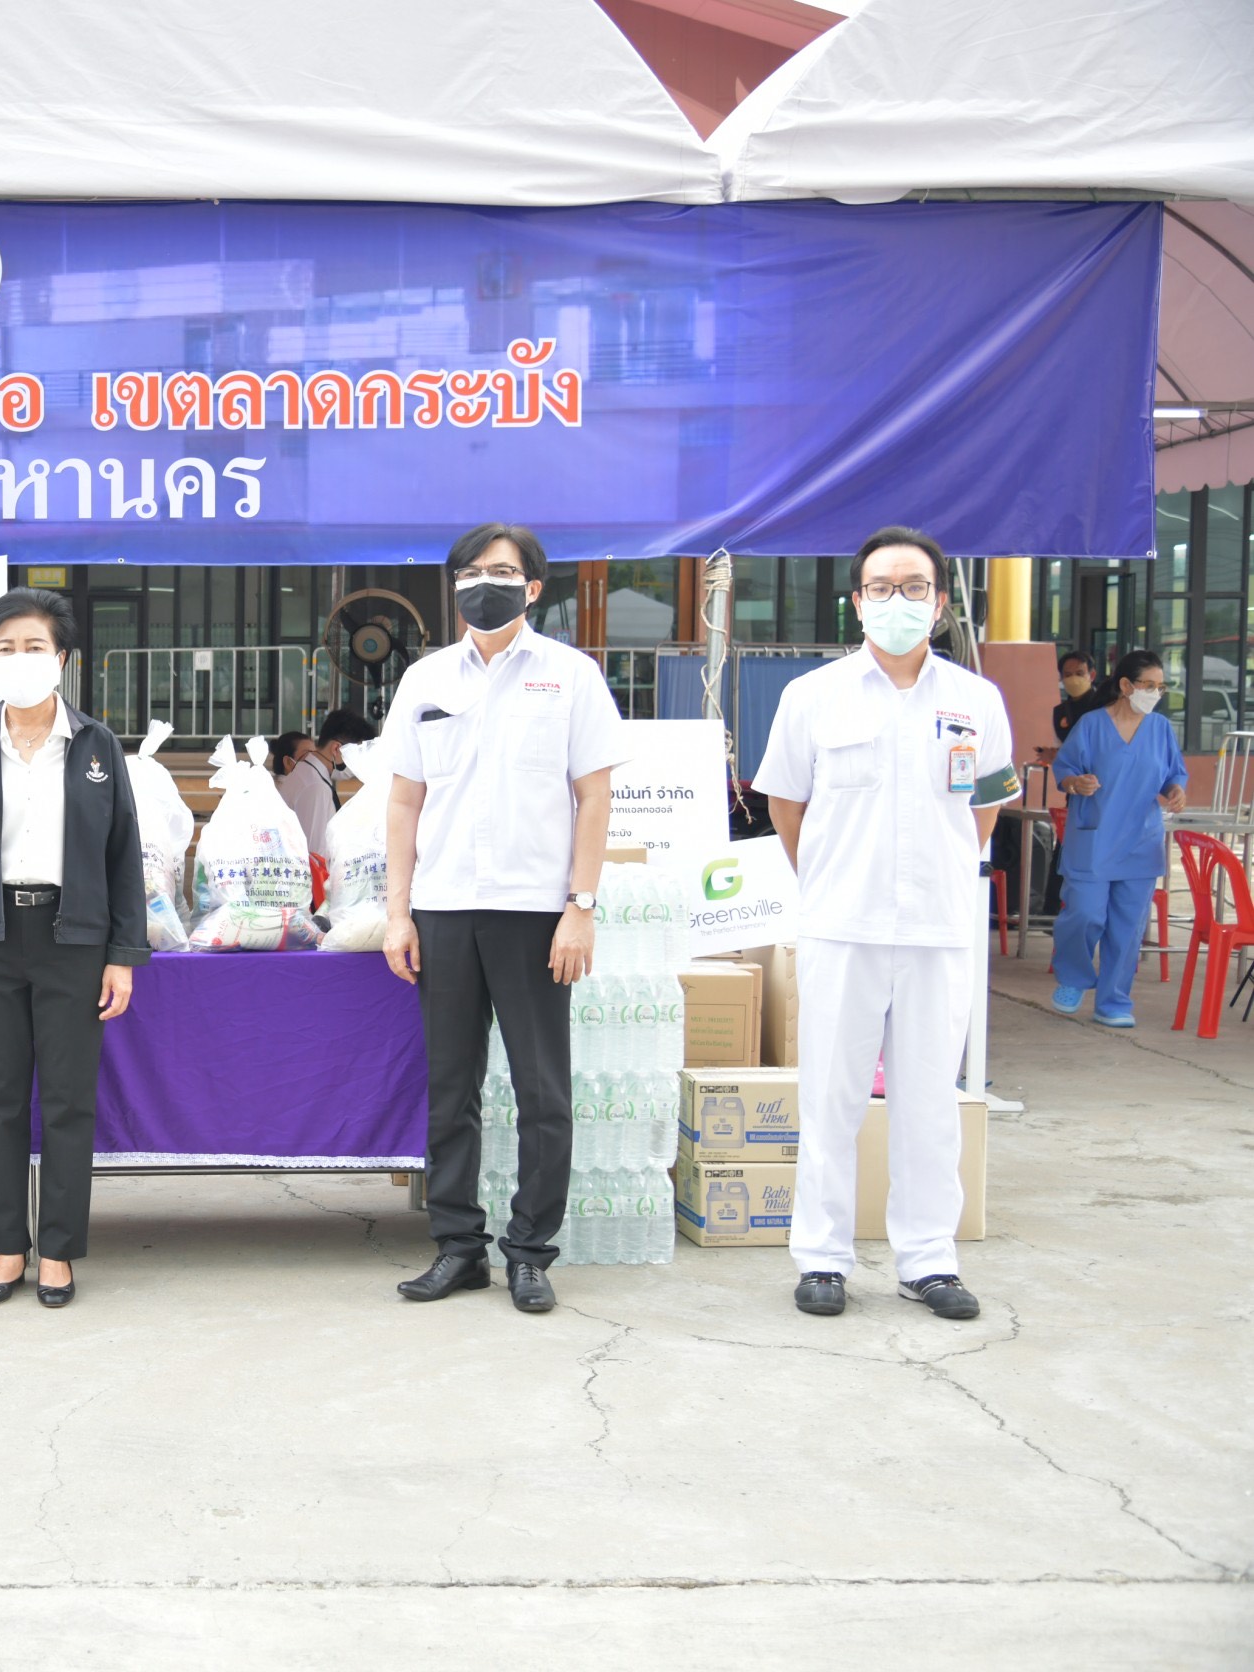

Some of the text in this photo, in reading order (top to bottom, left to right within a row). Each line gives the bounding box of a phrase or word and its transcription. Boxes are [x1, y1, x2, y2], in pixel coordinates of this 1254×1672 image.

[91, 337, 582, 430] เขตลาดกระบัง
[935, 710, 972, 721] HONDA
[656, 786, 694, 799] จำกัด
[762, 1186, 791, 1199] Babi
[765, 1198, 791, 1209] Mild
